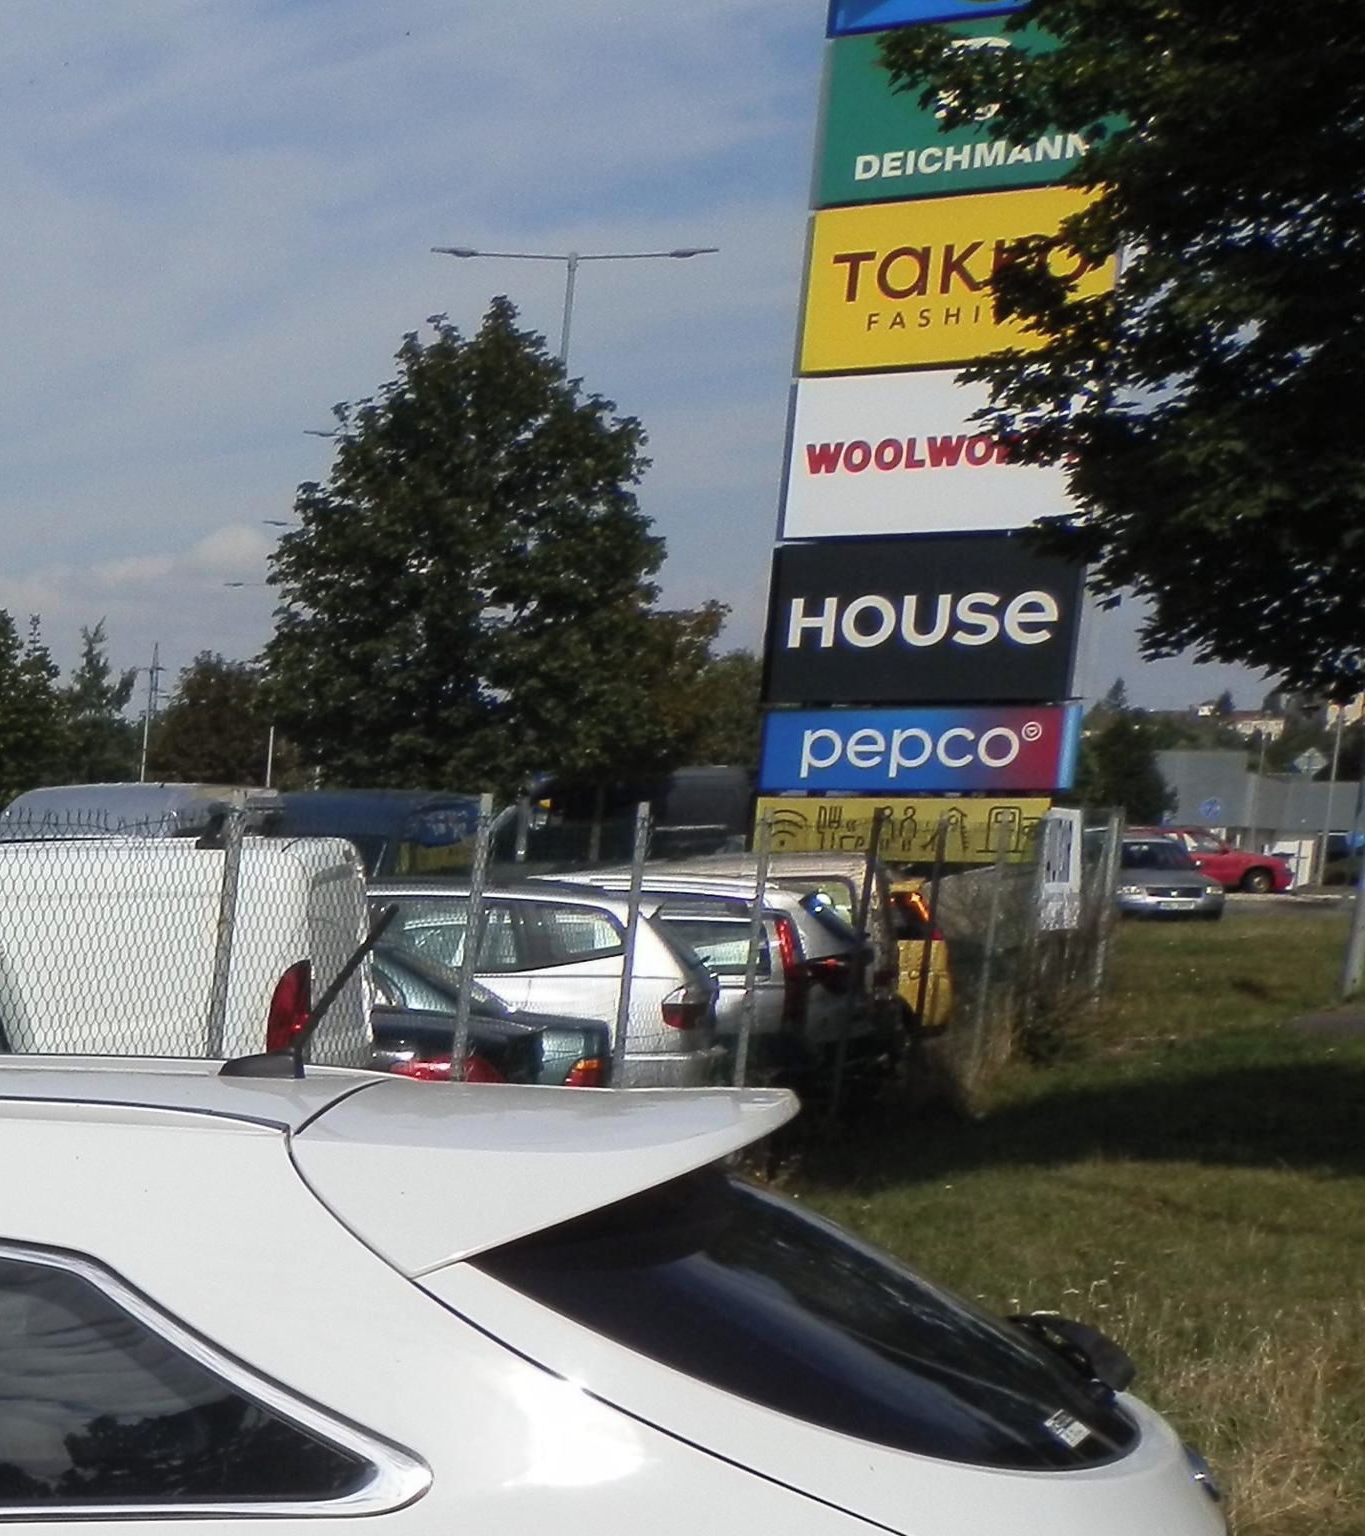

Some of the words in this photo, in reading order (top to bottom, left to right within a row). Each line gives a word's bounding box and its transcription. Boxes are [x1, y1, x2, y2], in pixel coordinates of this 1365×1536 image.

[866, 305, 981, 331] FASHI
[806, 434, 1017, 475] WOOLWO
[799, 727, 1020, 779] pepco
